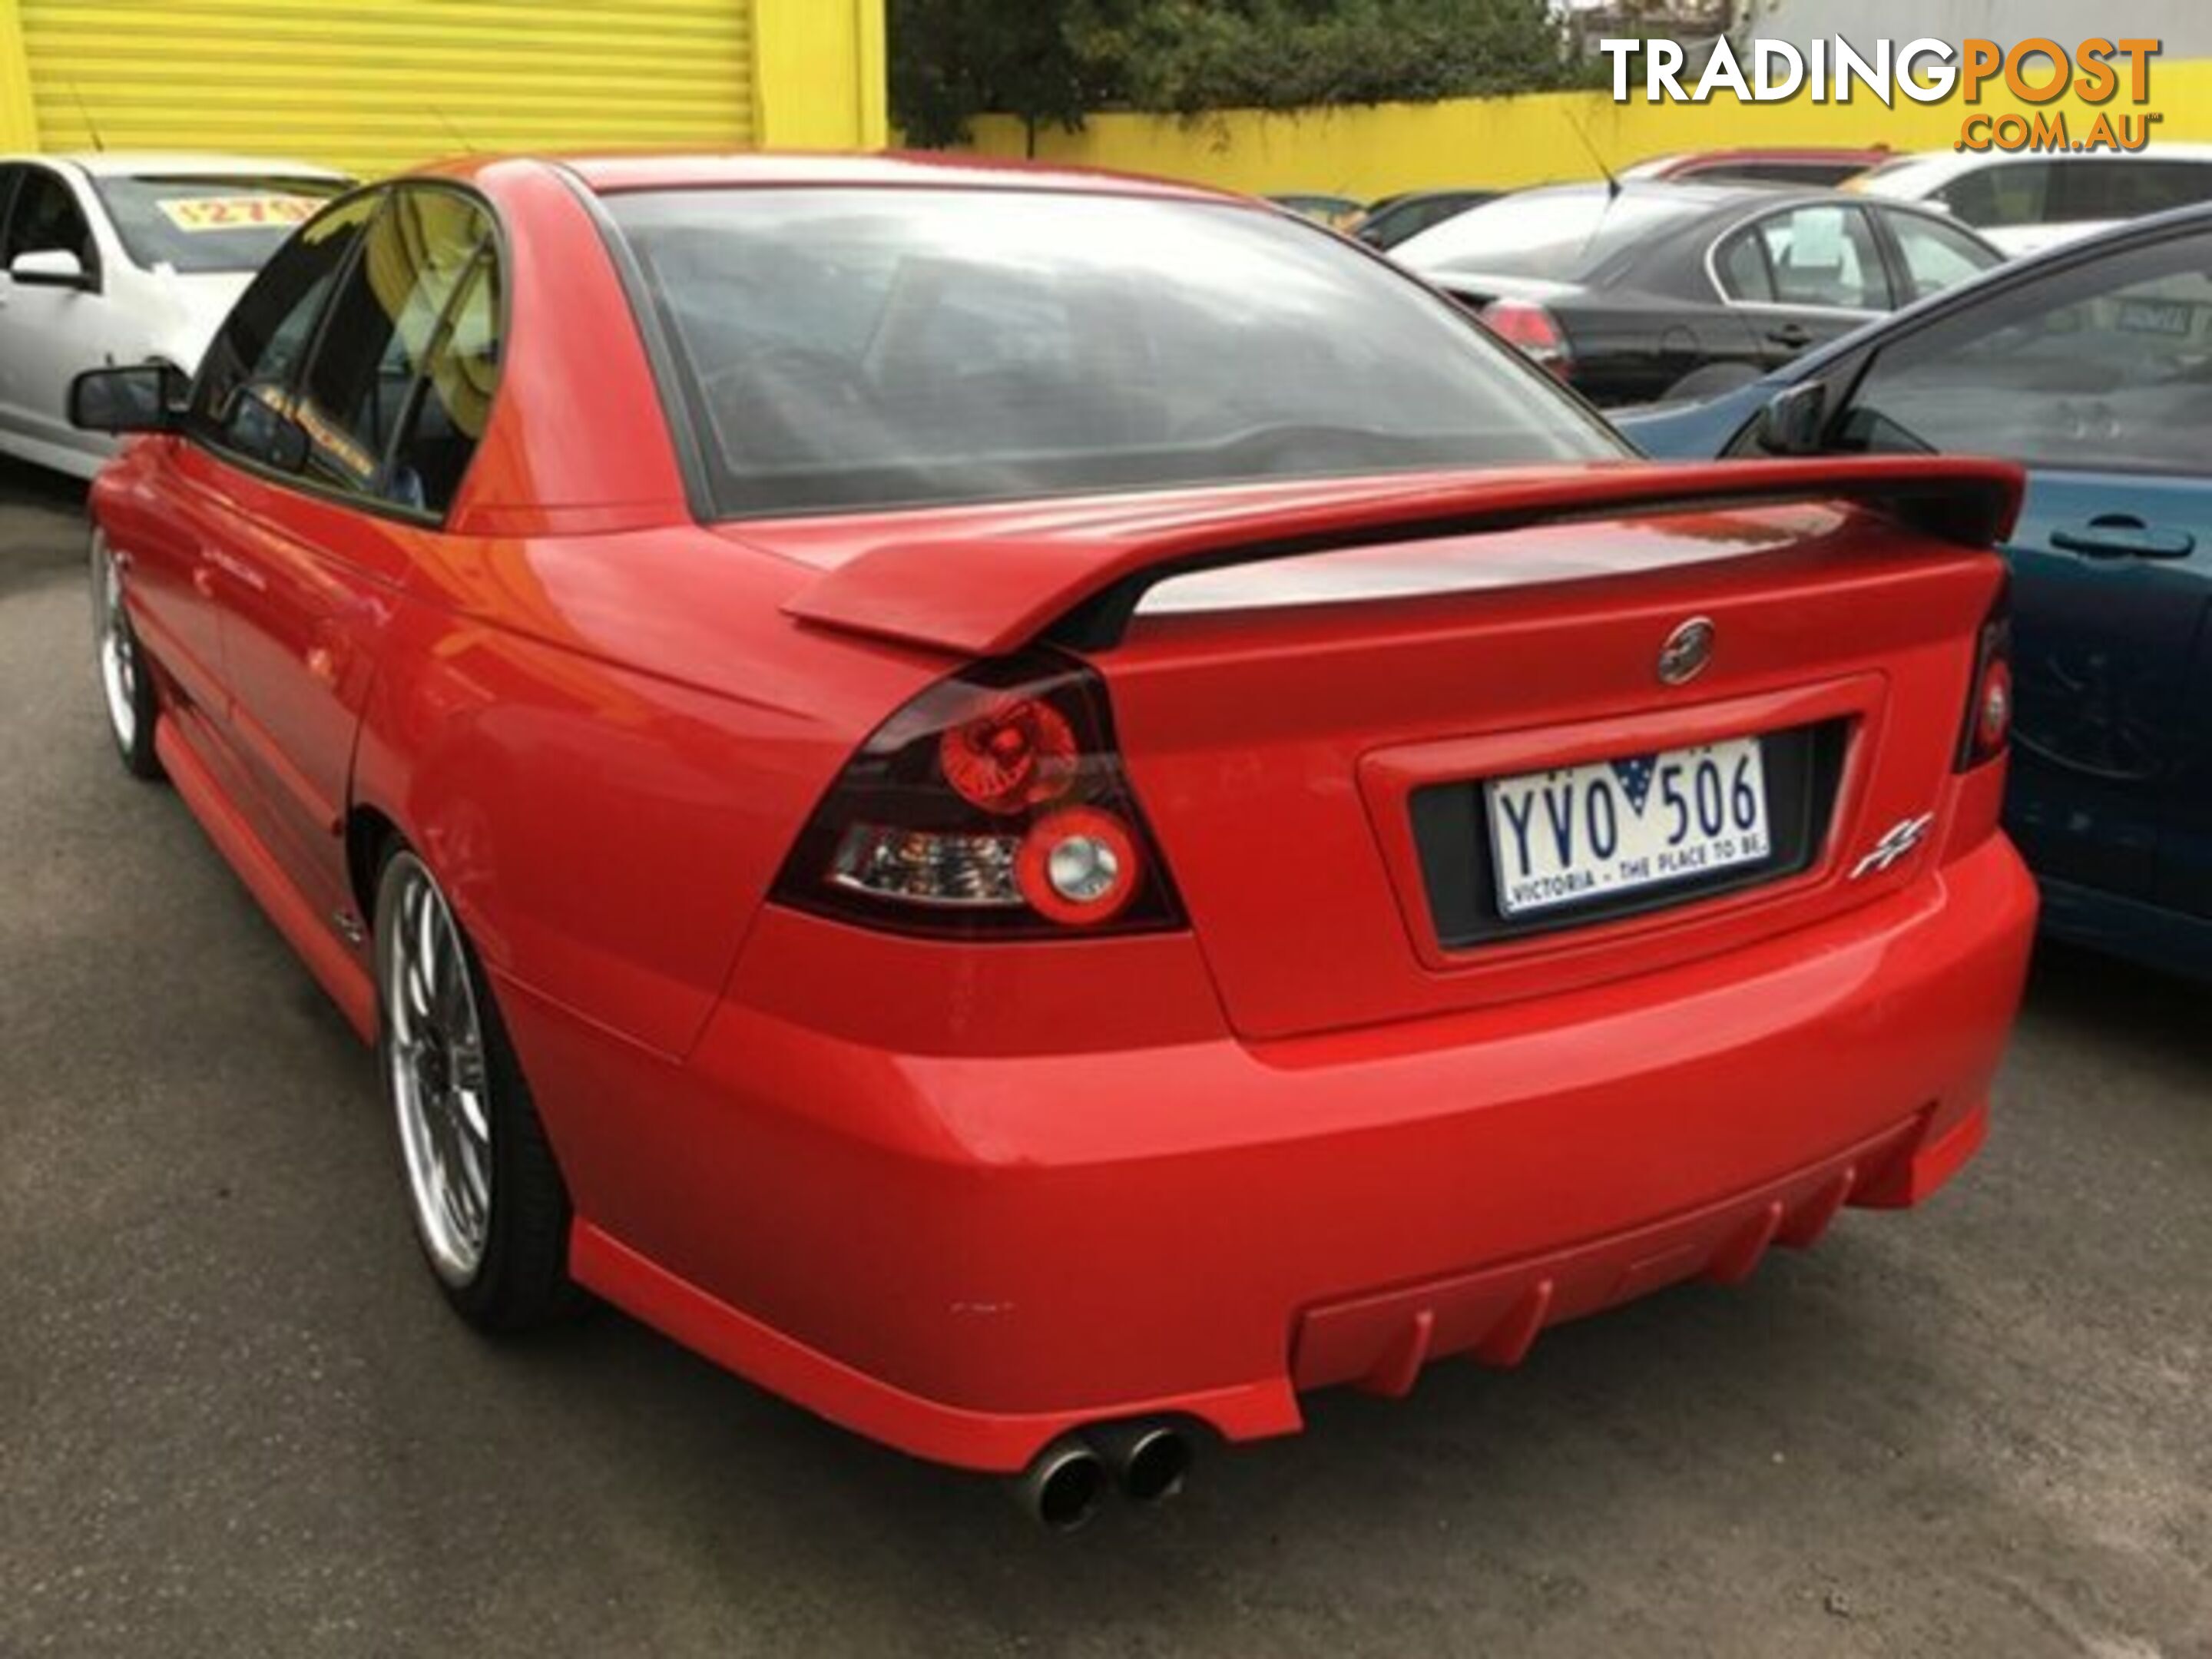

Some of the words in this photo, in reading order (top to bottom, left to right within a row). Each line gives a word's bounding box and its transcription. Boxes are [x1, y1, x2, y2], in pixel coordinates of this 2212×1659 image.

[1501, 777, 1618, 876] YVO
[1662, 753, 1757, 846] 506
[1512, 870, 1594, 903] VICTORIA
[1620, 856, 1650, 879] THE
[1658, 846, 1707, 871] PLACE
[1714, 840, 1736, 858] TO
[1741, 834, 1761, 855] BE
